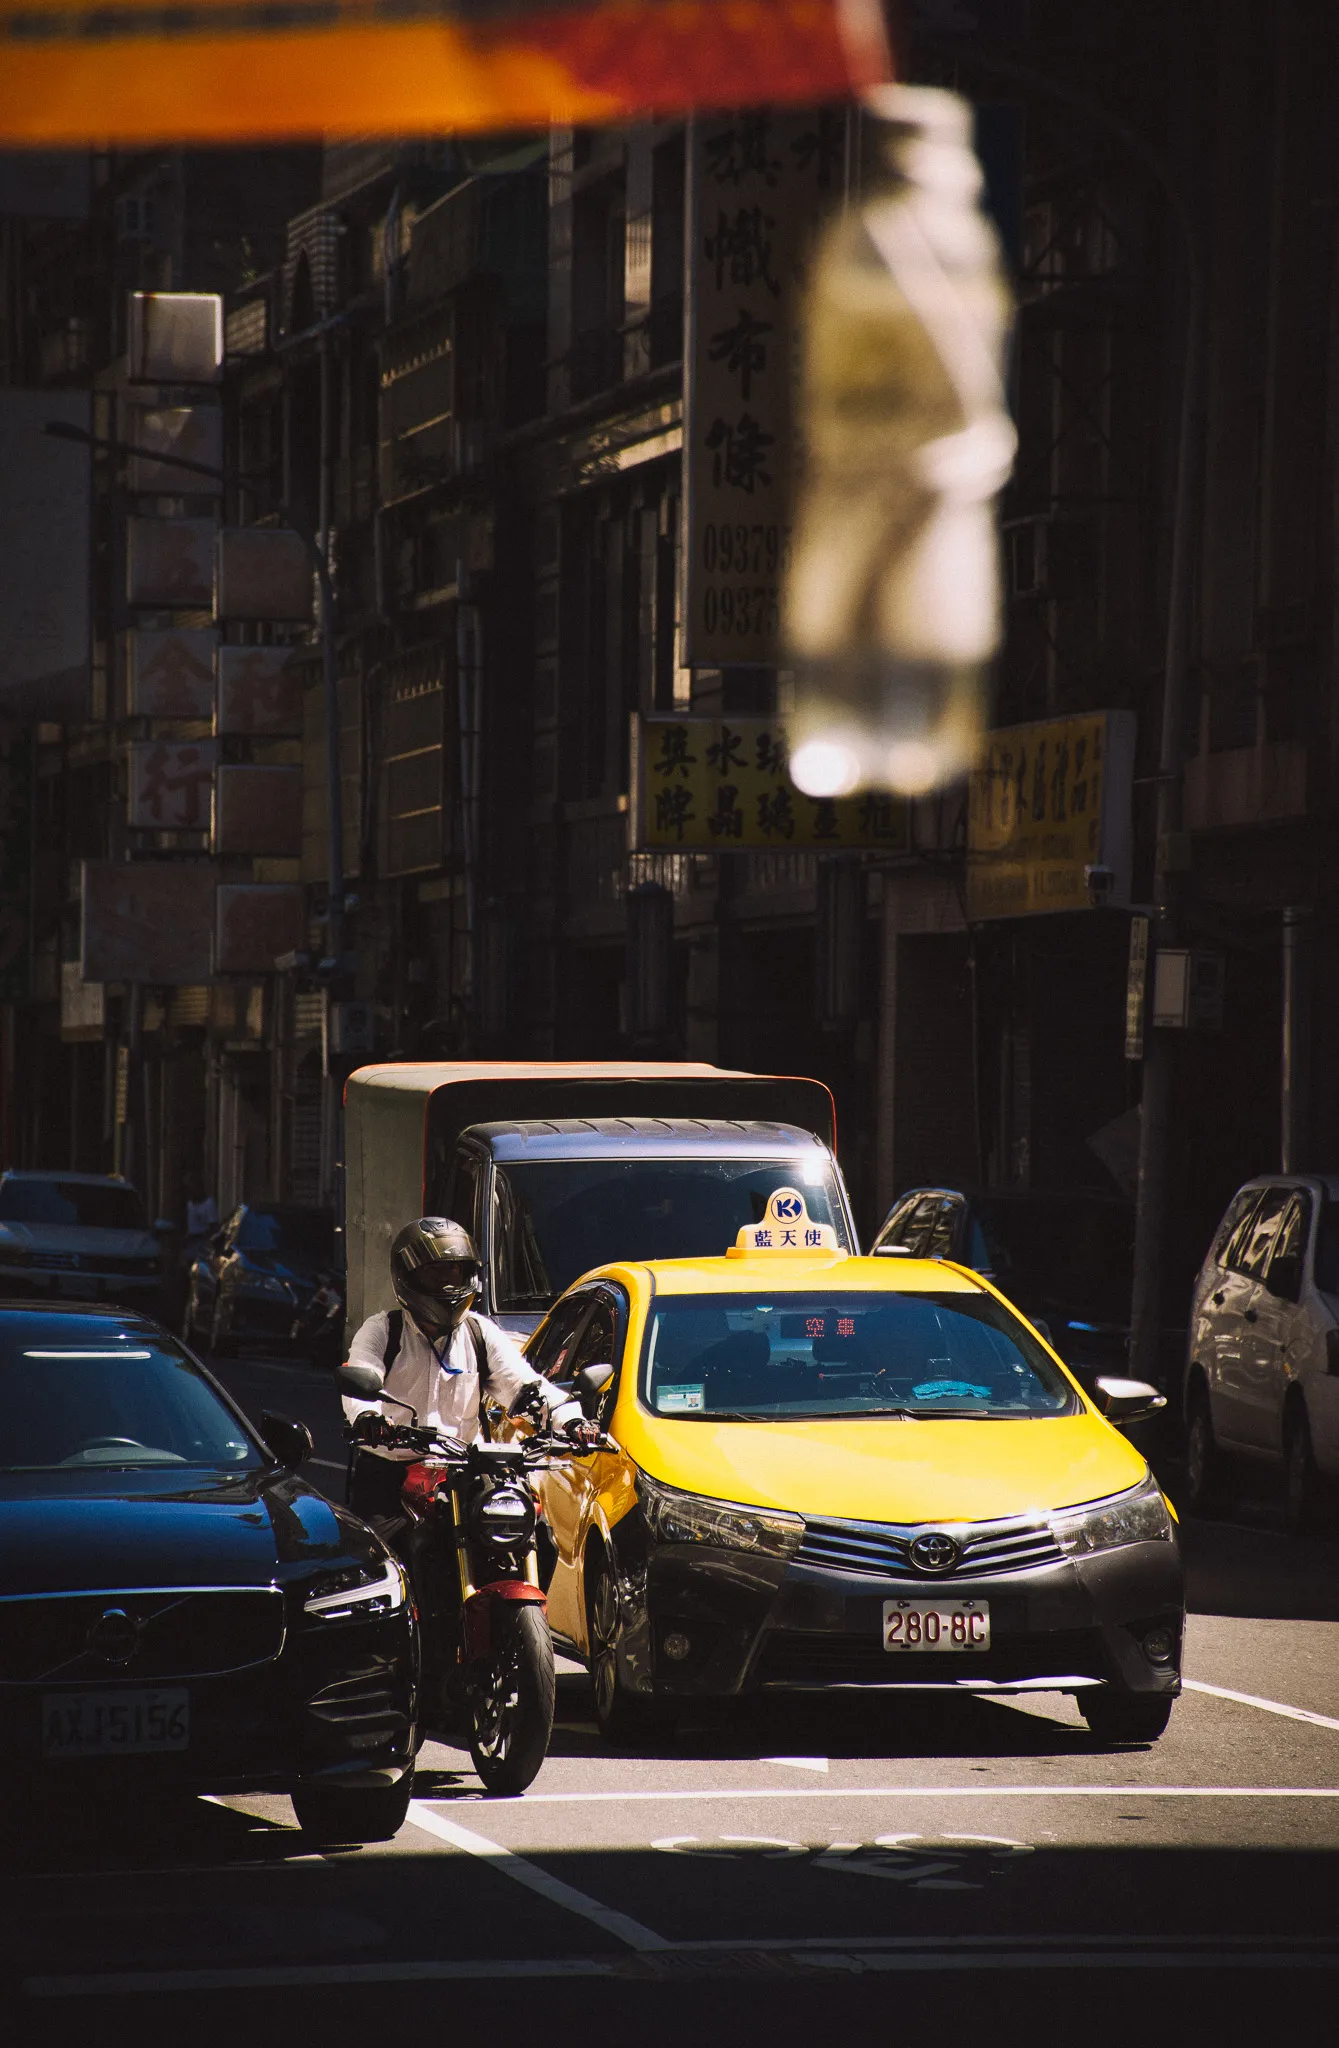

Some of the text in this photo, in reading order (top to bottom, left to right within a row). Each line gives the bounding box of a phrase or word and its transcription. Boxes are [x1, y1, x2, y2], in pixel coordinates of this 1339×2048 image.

[754, 1229, 822, 1247] 藍天使
[804, 1317, 856, 1338] 空車
[887, 1611, 985, 1643] 280-8C
